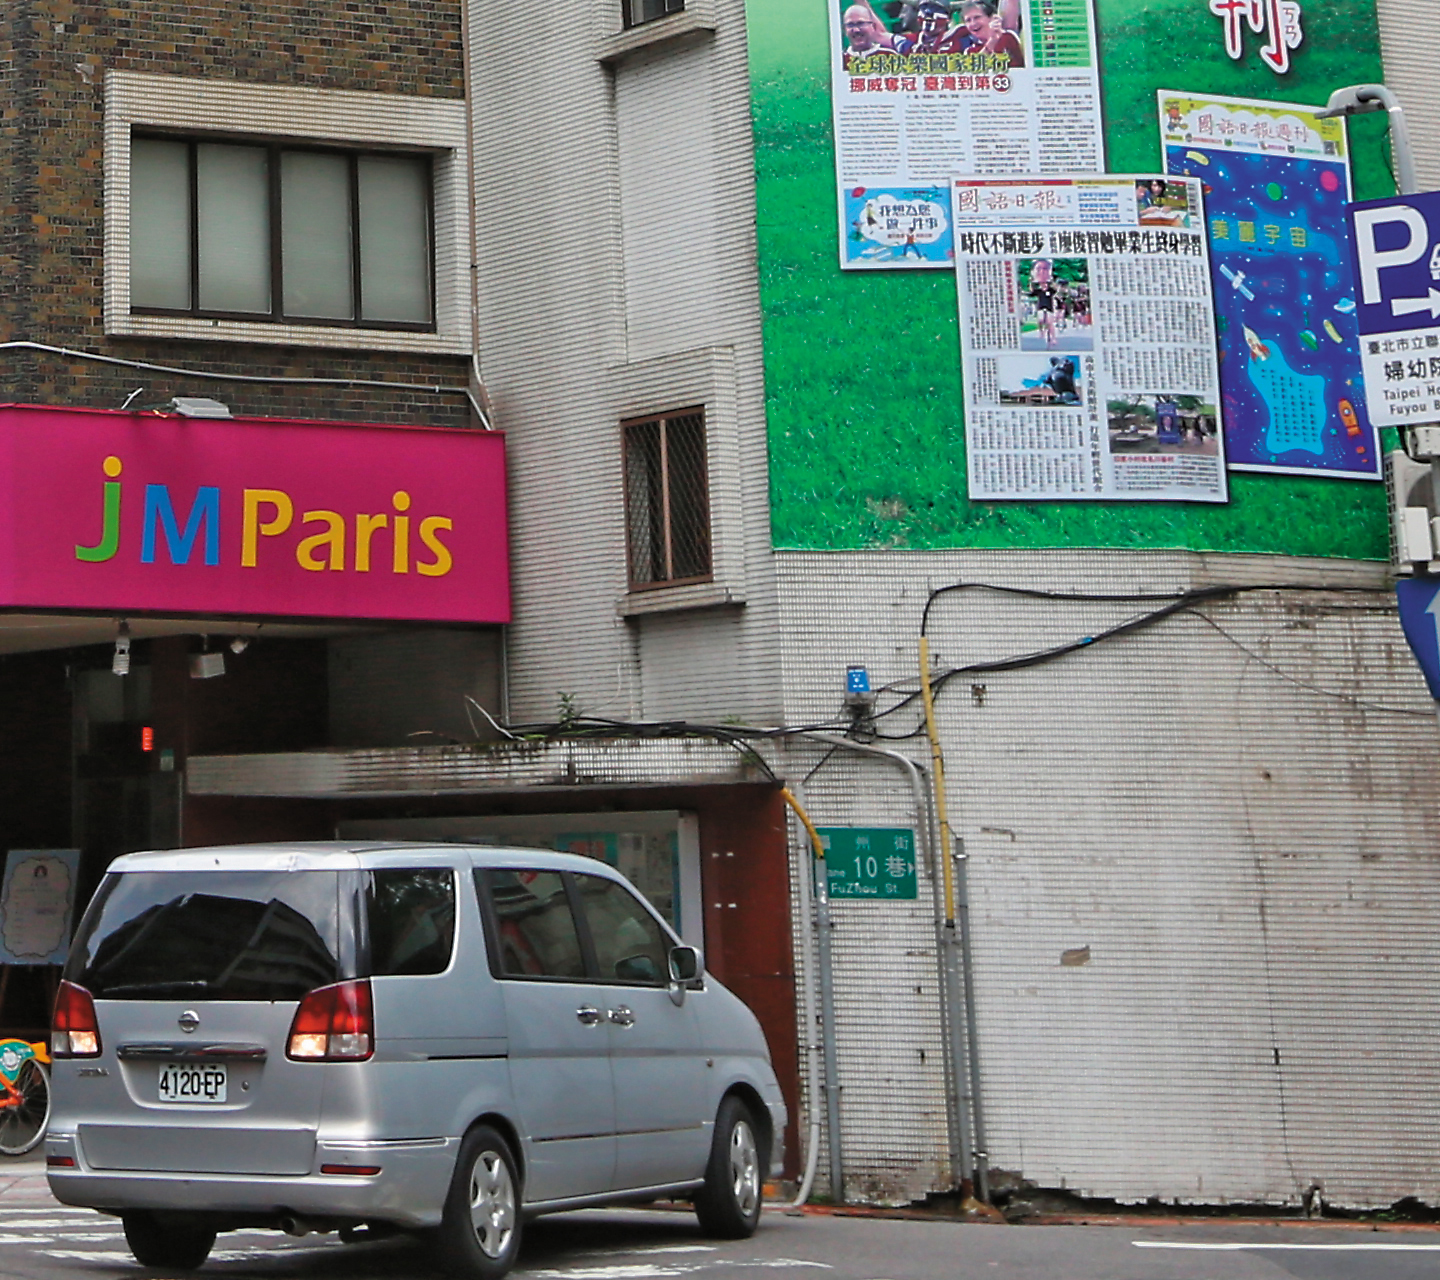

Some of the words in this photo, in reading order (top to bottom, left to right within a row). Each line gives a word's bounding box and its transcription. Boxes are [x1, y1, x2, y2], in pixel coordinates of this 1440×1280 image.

[1354, 205, 1429, 305] P
[1383, 384, 1421, 401] Taipei
[1390, 402, 1427, 417] Fuyou
[854, 856, 877, 878] 10
[885, 855, 907, 877] 巷
[160, 1071, 225, 1096] 4120-EP
